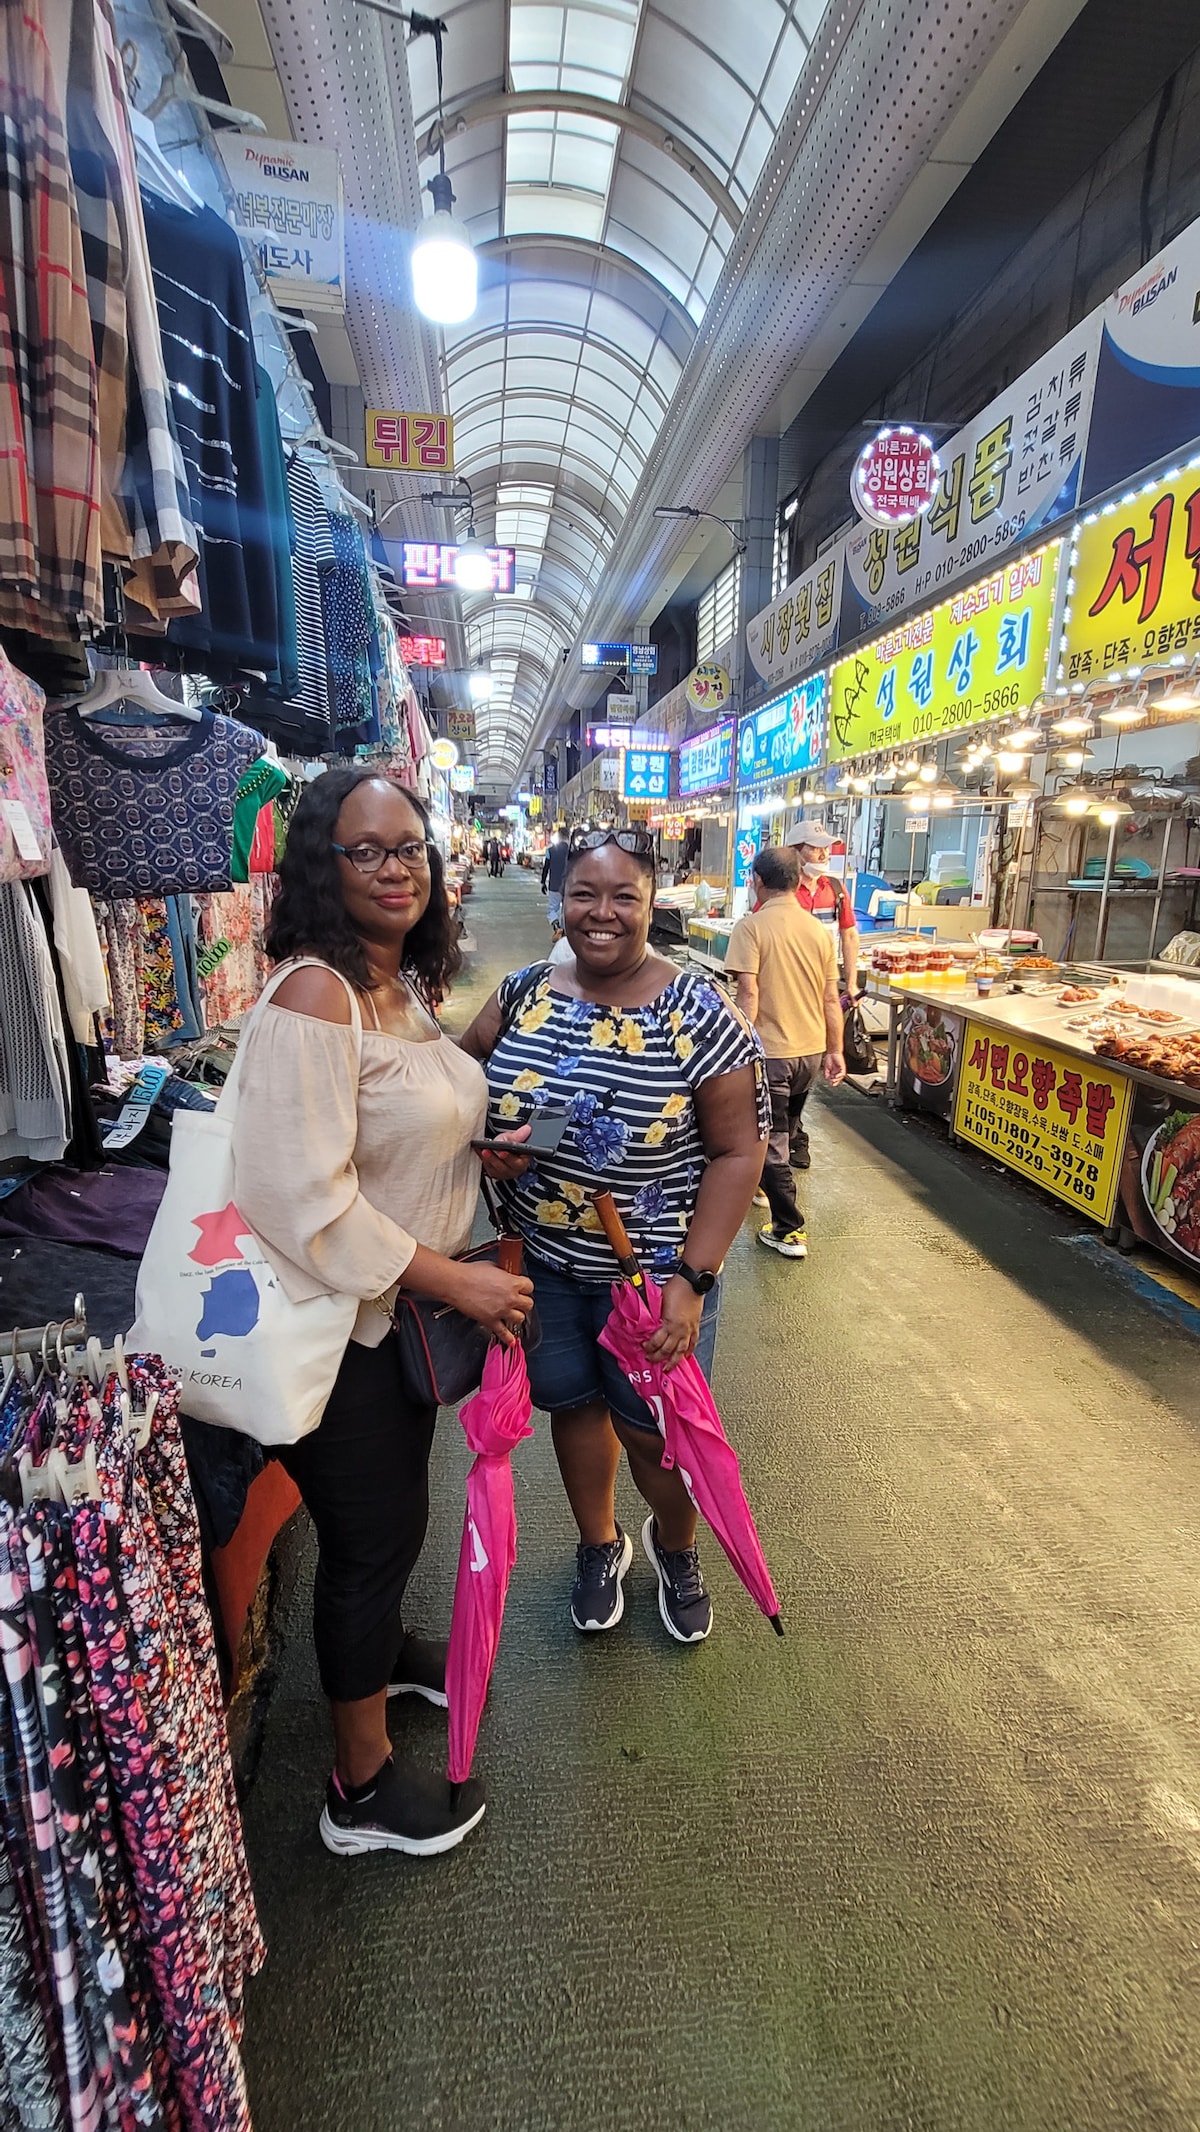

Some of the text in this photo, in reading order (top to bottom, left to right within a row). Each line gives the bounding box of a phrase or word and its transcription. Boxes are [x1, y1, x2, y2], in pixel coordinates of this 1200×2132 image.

[245, 148, 295, 168] Dynamic
[263, 164, 310, 182] BUSAN
[1132, 265, 1179, 317] BUSAN
[1026, 350, 1087, 424] 김치류
[373, 416, 450, 467] 튀김
[878, 440, 923, 457] 마른고기
[1022, 391, 1082, 460] 젓갈류
[866, 457, 931, 493] 성원상회
[1017, 431, 1077, 496] 반찬류
[876, 494, 921, 509] 전국택배
[934, 509, 1027, 583] 010-2800-5866
[760, 559, 836, 665] 시장횟집
[949, 555, 1043, 626] 제수고기 일체
[873, 606, 1032, 721] 성원상회
[874, 614, 936, 667] 마른고기전문
[696, 665, 722, 681] 시장
[912, 682, 1021, 736] 010-2800-5866
[967, 1036, 1116, 1140] 서면오향족발
[963, 1114, 1096, 1202] H.010-2929-7789
[965, 1098, 1099, 1183] T.(051)807-3978
[189, 1369, 243, 1392] KOREA
